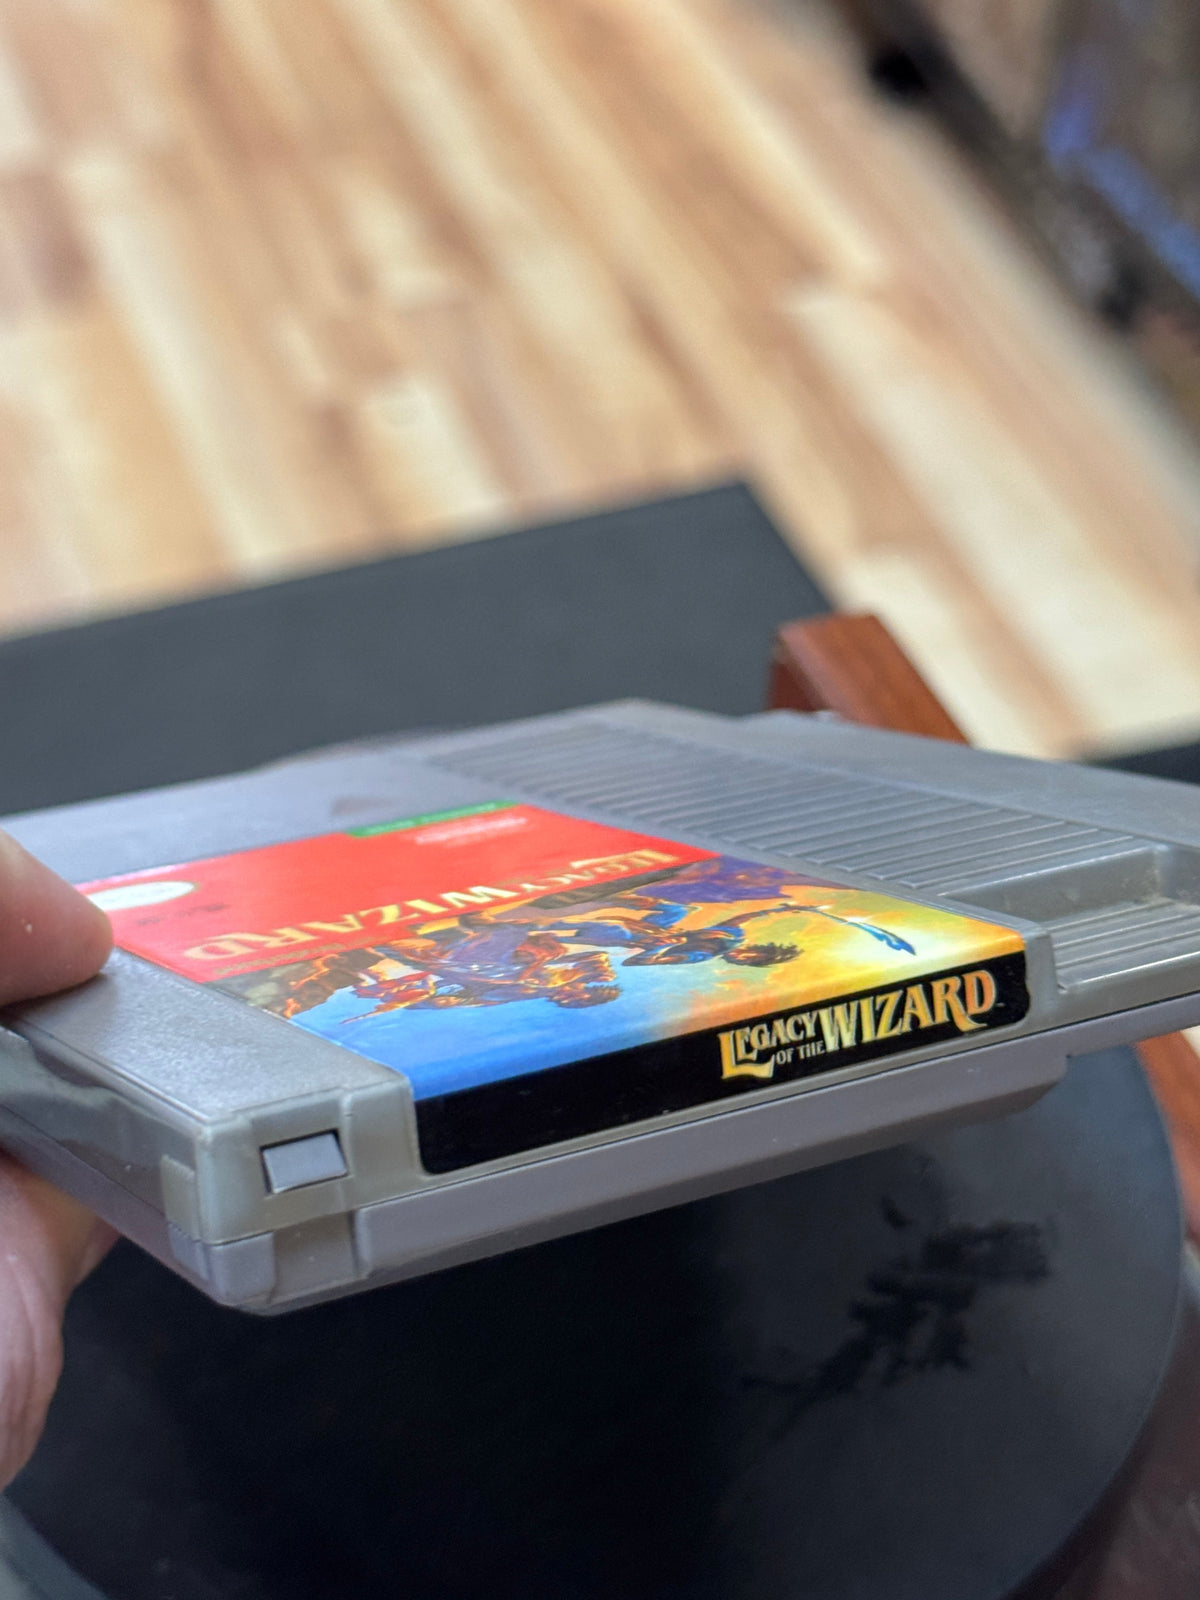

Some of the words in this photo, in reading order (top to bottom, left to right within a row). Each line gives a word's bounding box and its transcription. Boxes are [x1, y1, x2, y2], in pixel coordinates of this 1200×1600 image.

[519, 848, 680, 893] LEGACY
[183, 885, 519, 962] WIZARD
[717, 1009, 820, 1080] LEGACY
[818, 969, 997, 1053] WIZARD
[776, 1048, 793, 1066] OF
[798, 1041, 826, 1060] THE
